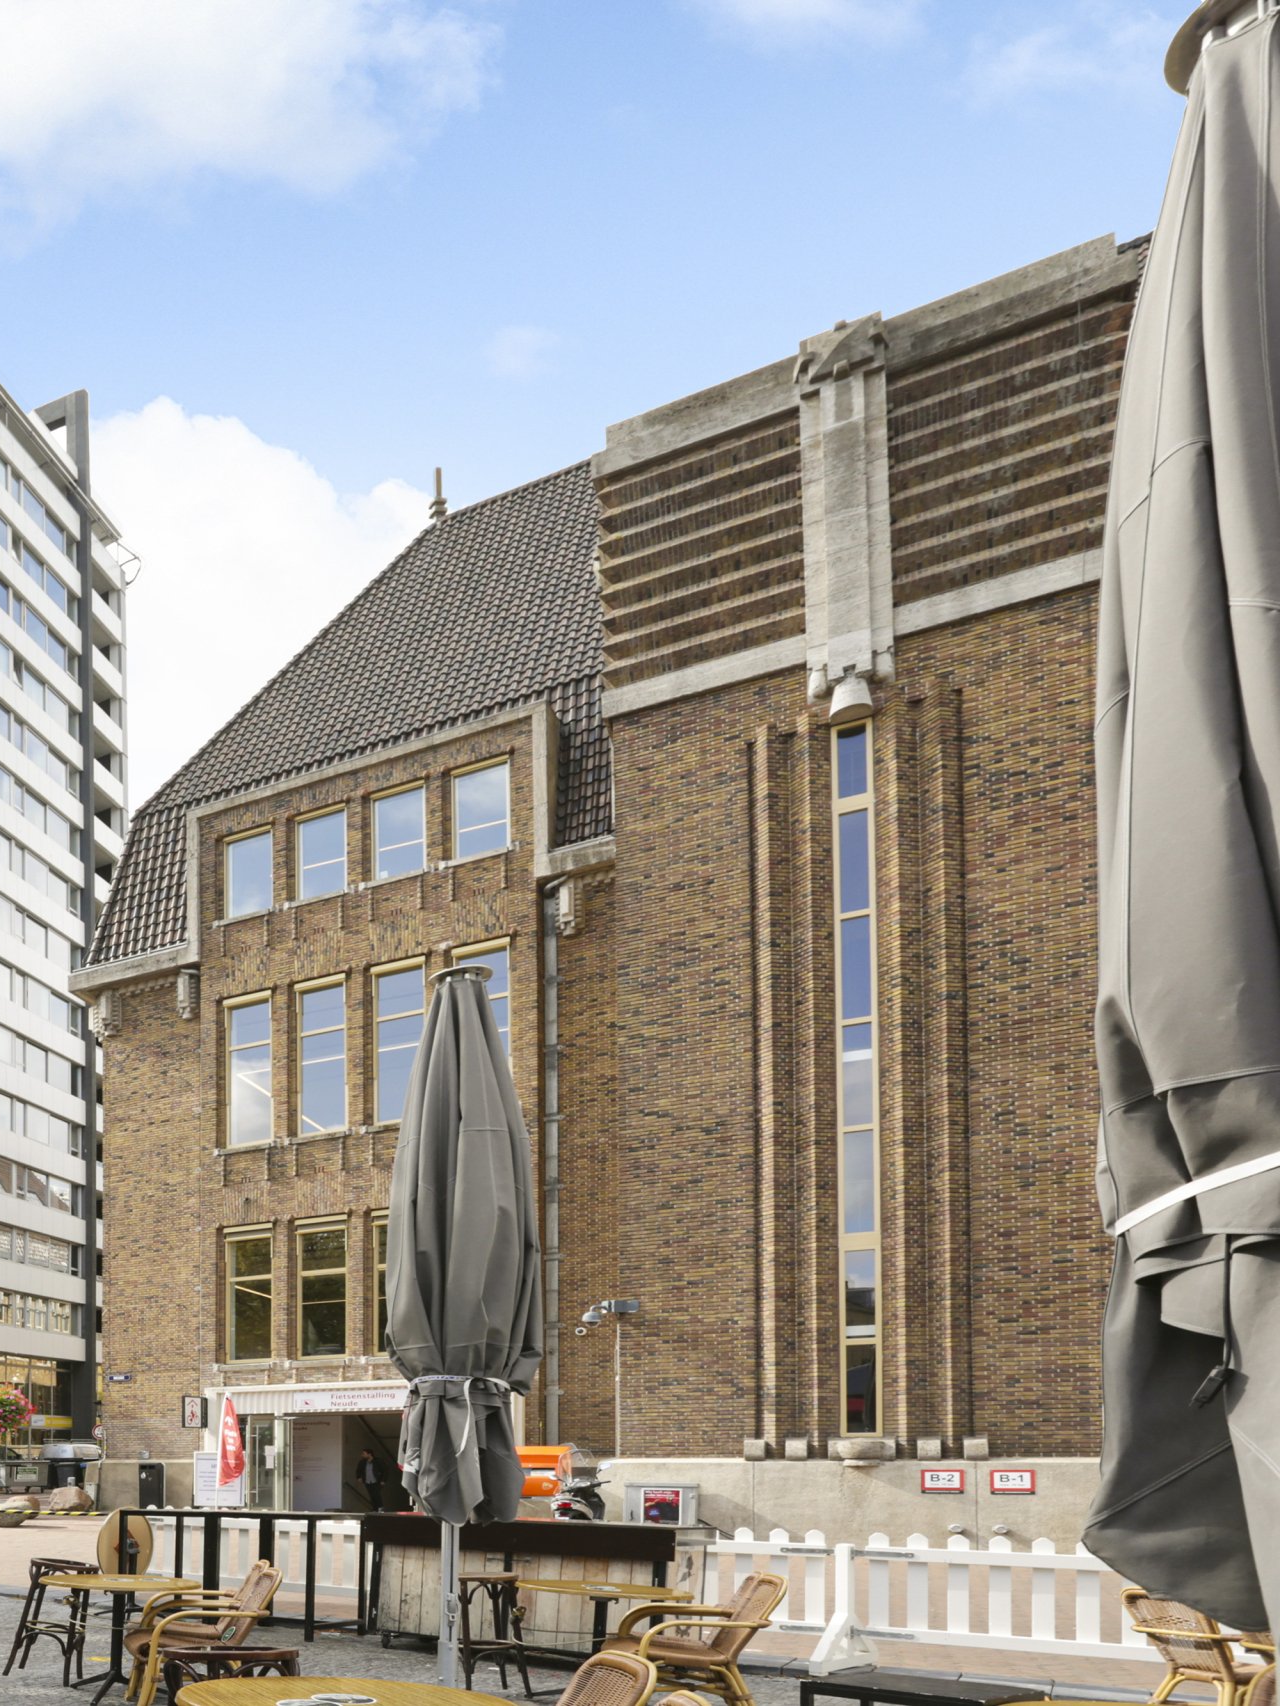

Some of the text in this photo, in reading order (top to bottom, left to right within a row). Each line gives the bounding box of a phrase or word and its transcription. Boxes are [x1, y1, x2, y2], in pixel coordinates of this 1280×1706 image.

[330, 1391, 396, 1400] Fietsenstalling
[929, 1473, 955, 1482] B-2
[999, 1474, 1024, 1483] B-1
